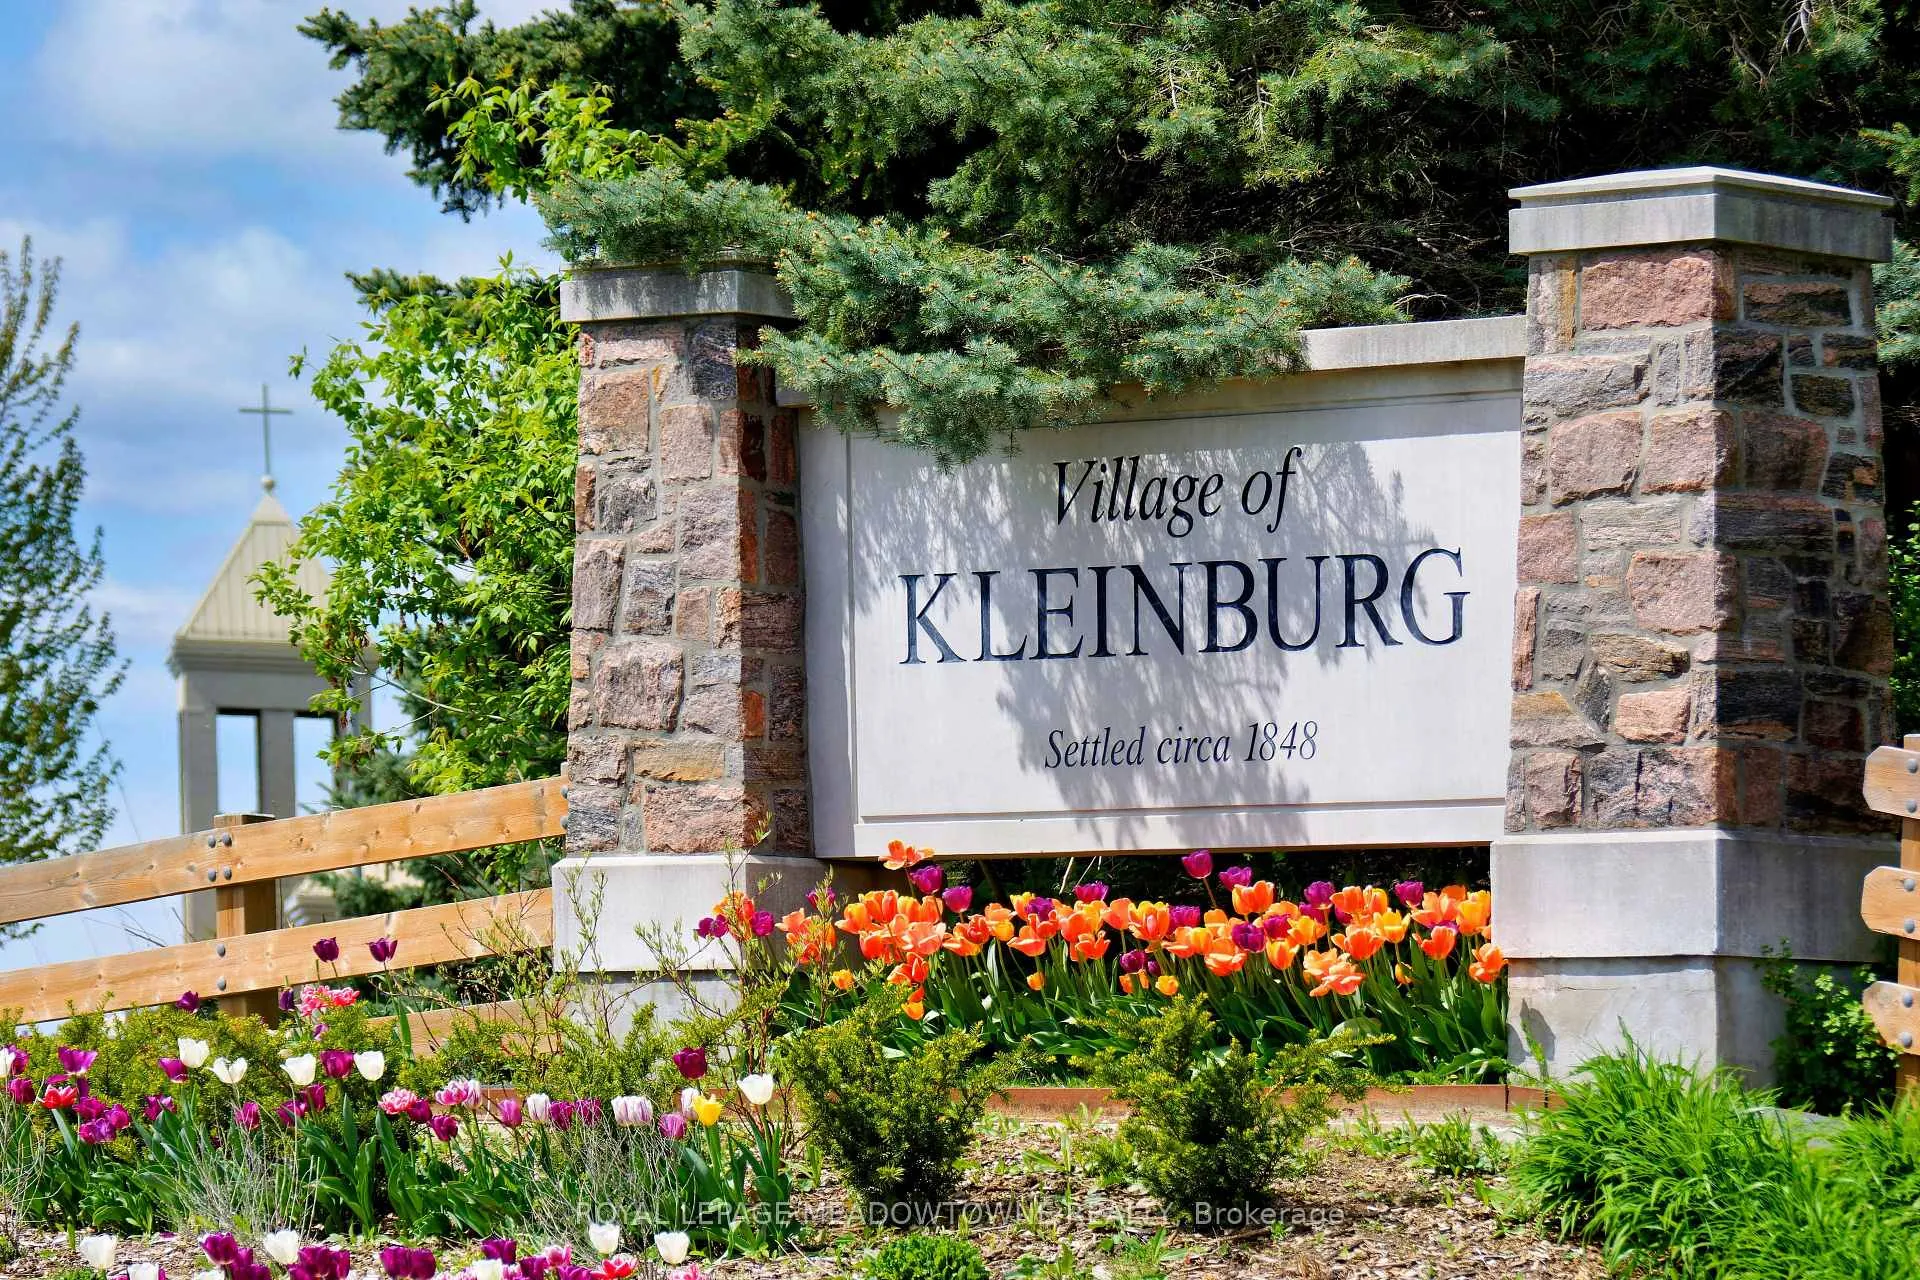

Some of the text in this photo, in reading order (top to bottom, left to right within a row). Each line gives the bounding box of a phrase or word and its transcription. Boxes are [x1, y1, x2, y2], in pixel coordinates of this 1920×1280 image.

[1054, 447, 1303, 538] Village of
[898, 548, 1471, 664] KLEINBURG
[1044, 720, 1318, 769] Settled circa 1848
